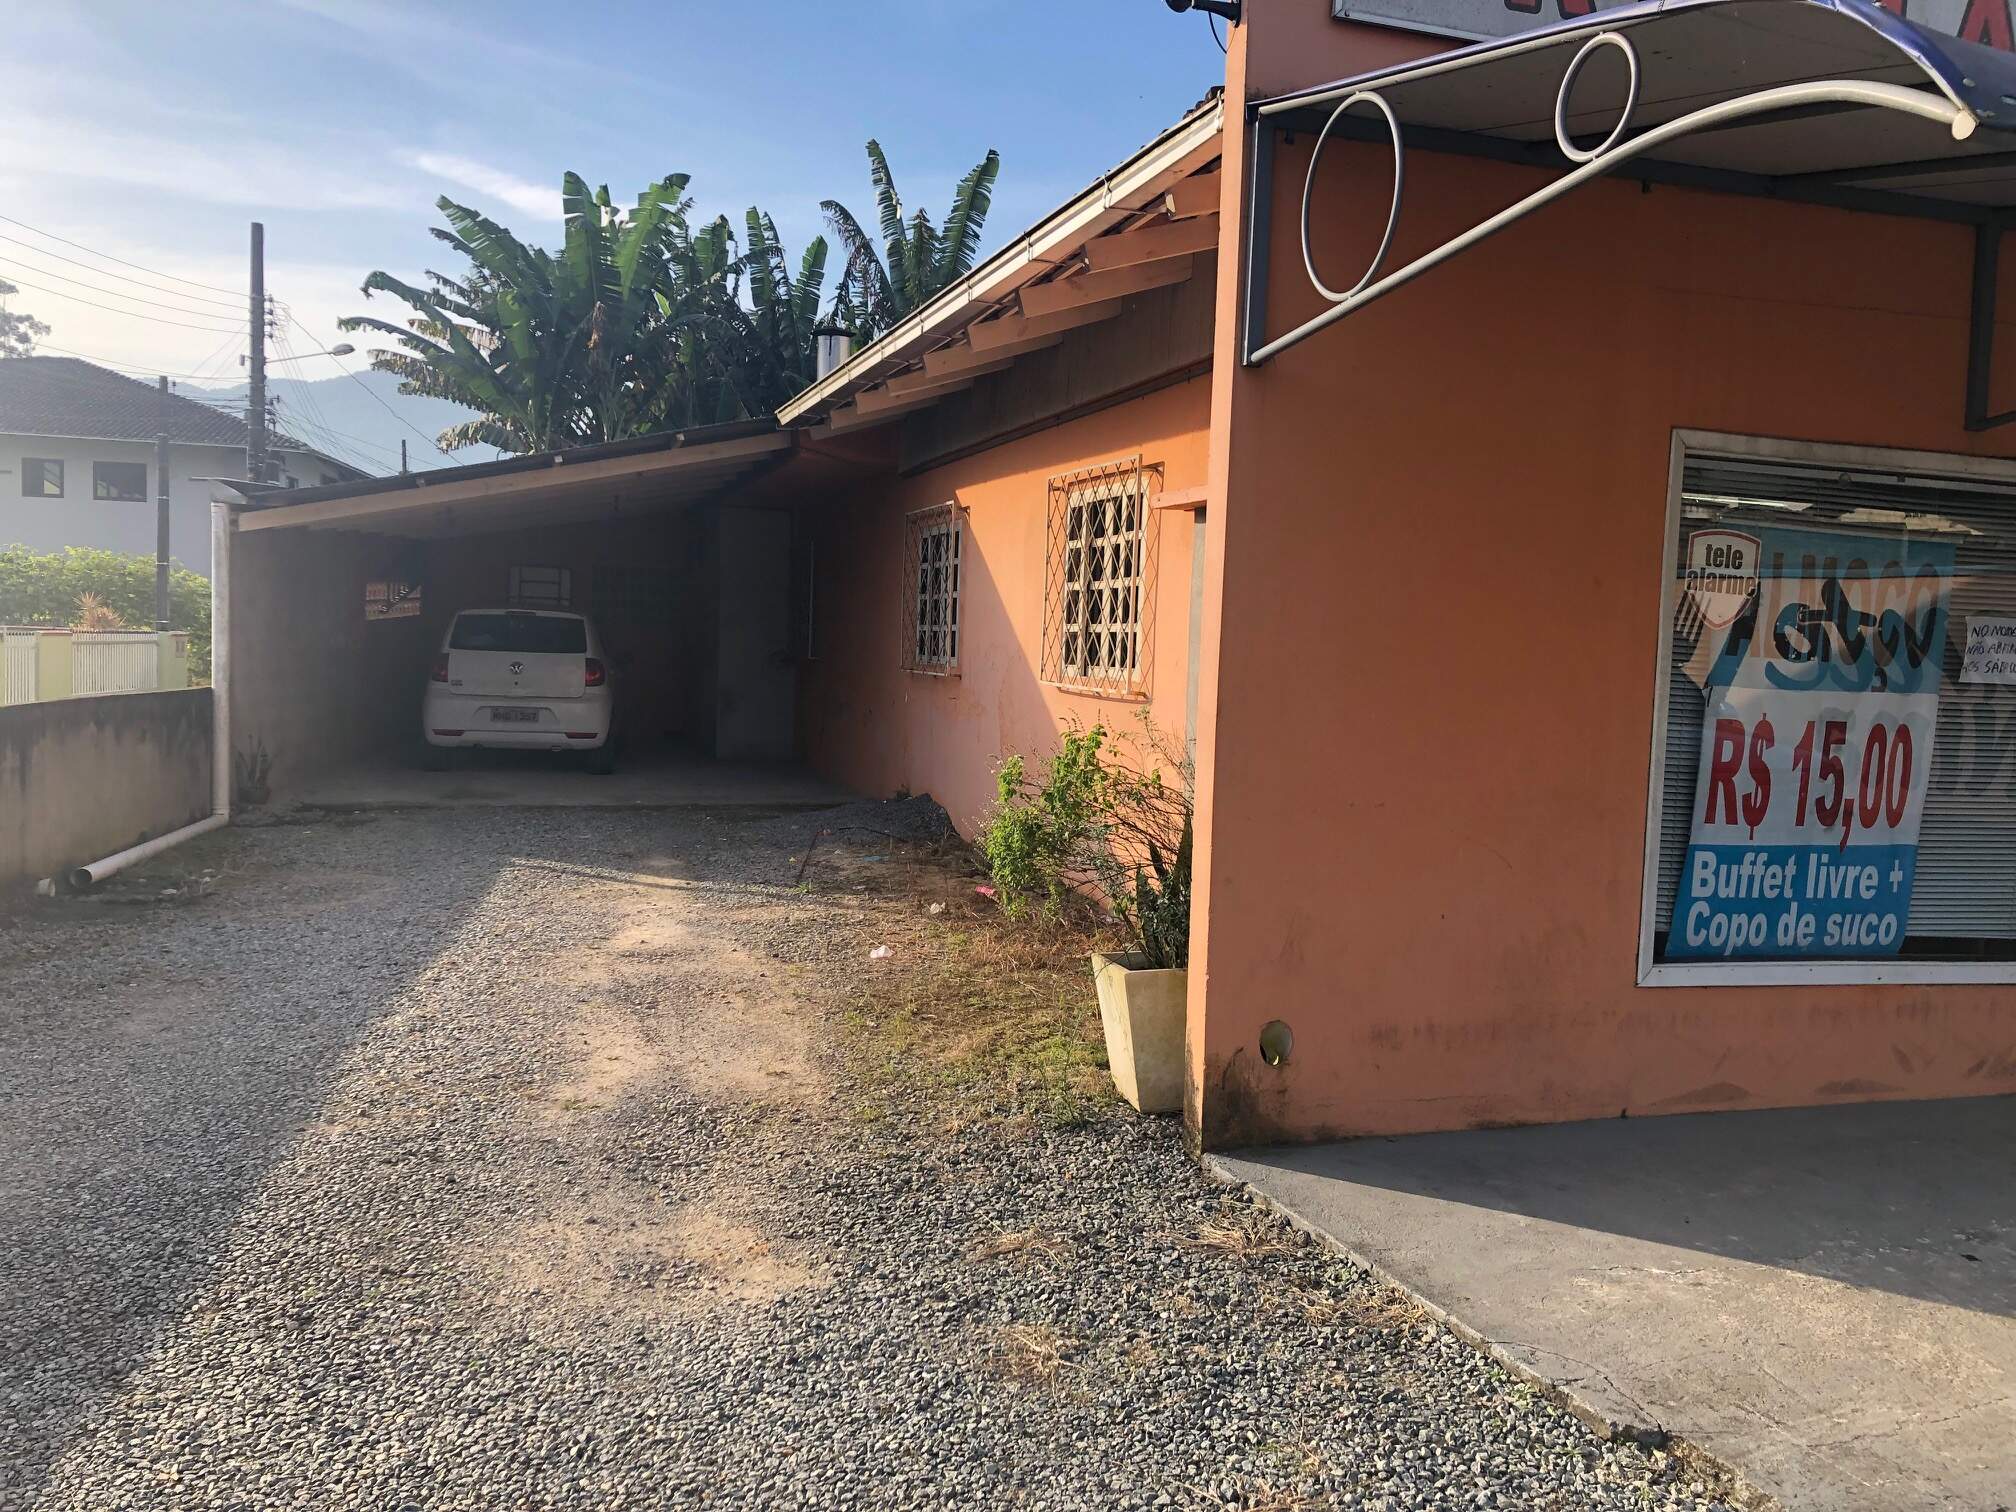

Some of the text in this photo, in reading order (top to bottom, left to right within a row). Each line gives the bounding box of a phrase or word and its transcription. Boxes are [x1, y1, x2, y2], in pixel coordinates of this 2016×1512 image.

[1705, 543, 1744, 570] tele
[1686, 567, 1757, 598] alarme
[1704, 713, 1913, 854] R$ 15,00
[1691, 850, 1797, 899] Buffet
[1806, 852, 1879, 900] livre
[1686, 900, 1898, 956] Copo de suco
